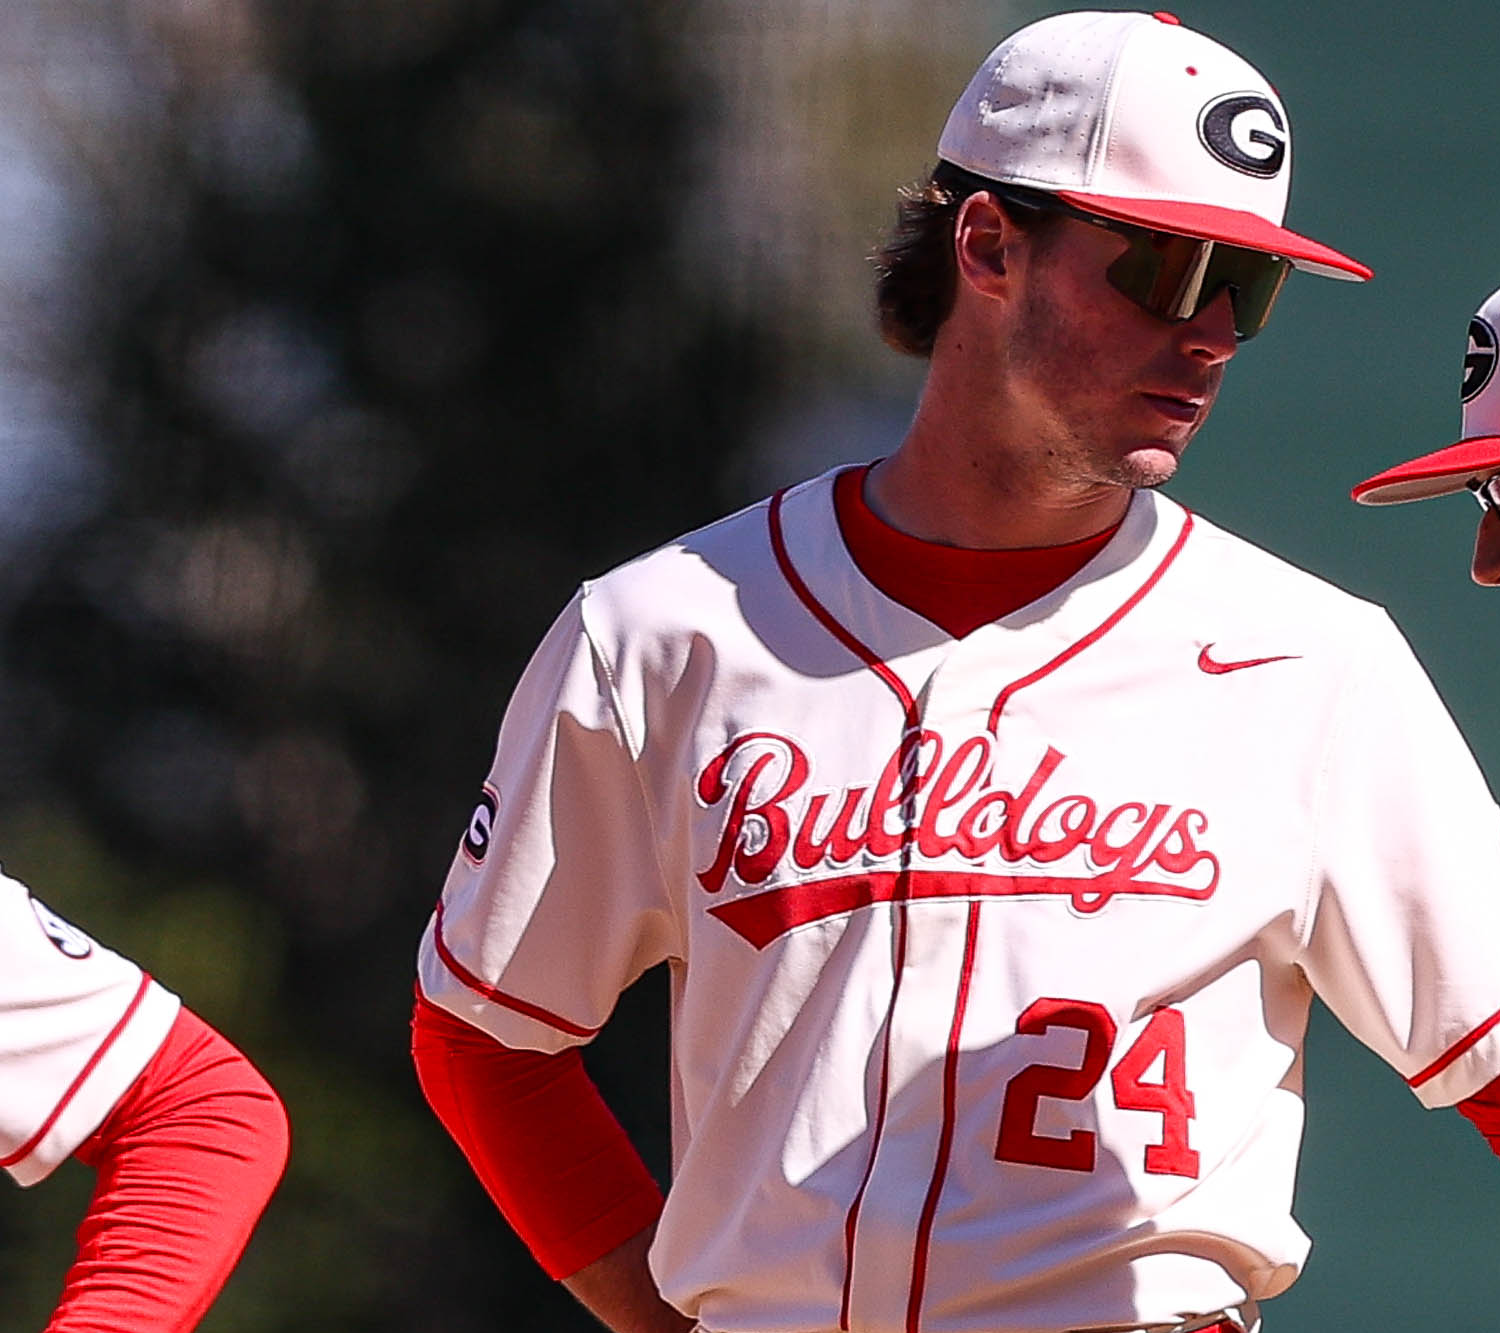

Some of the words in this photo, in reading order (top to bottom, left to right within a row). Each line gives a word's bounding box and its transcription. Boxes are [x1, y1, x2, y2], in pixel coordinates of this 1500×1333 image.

[1198, 91, 1287, 179] G
[696, 729, 1220, 913] Bulldogs
[995, 997, 1199, 1178] 24
